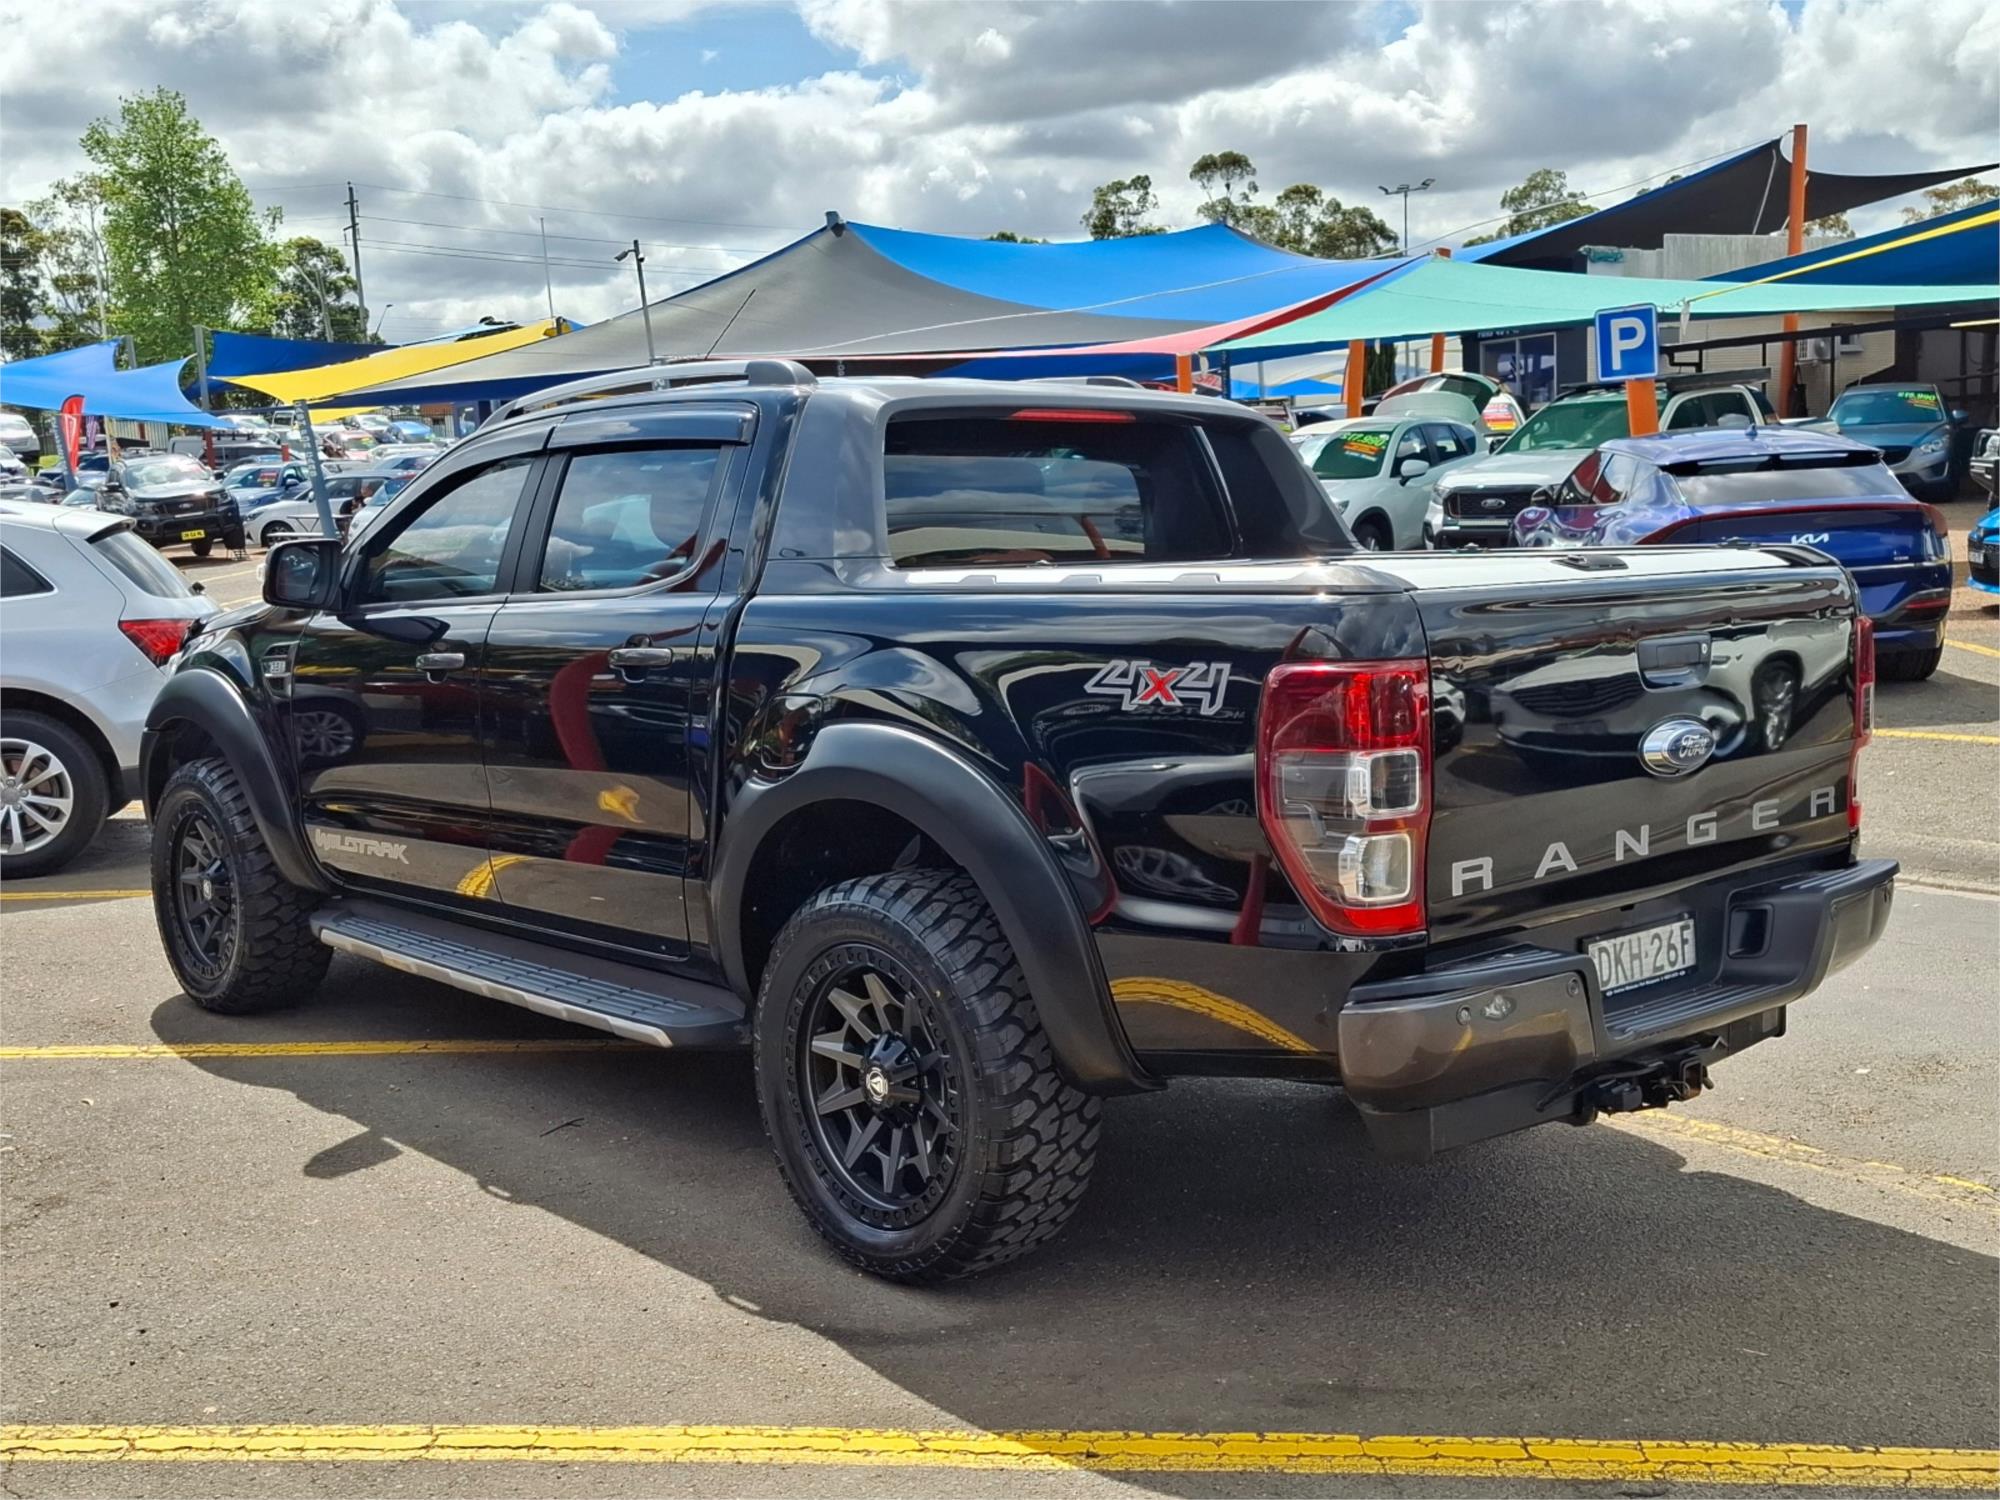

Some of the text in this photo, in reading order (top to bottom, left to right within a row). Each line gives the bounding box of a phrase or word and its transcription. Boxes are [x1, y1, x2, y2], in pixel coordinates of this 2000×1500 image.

[1611, 318, 1645, 370] P
[315, 828, 410, 865] WILDTRAK
[1452, 786, 1836, 896] RANGER
